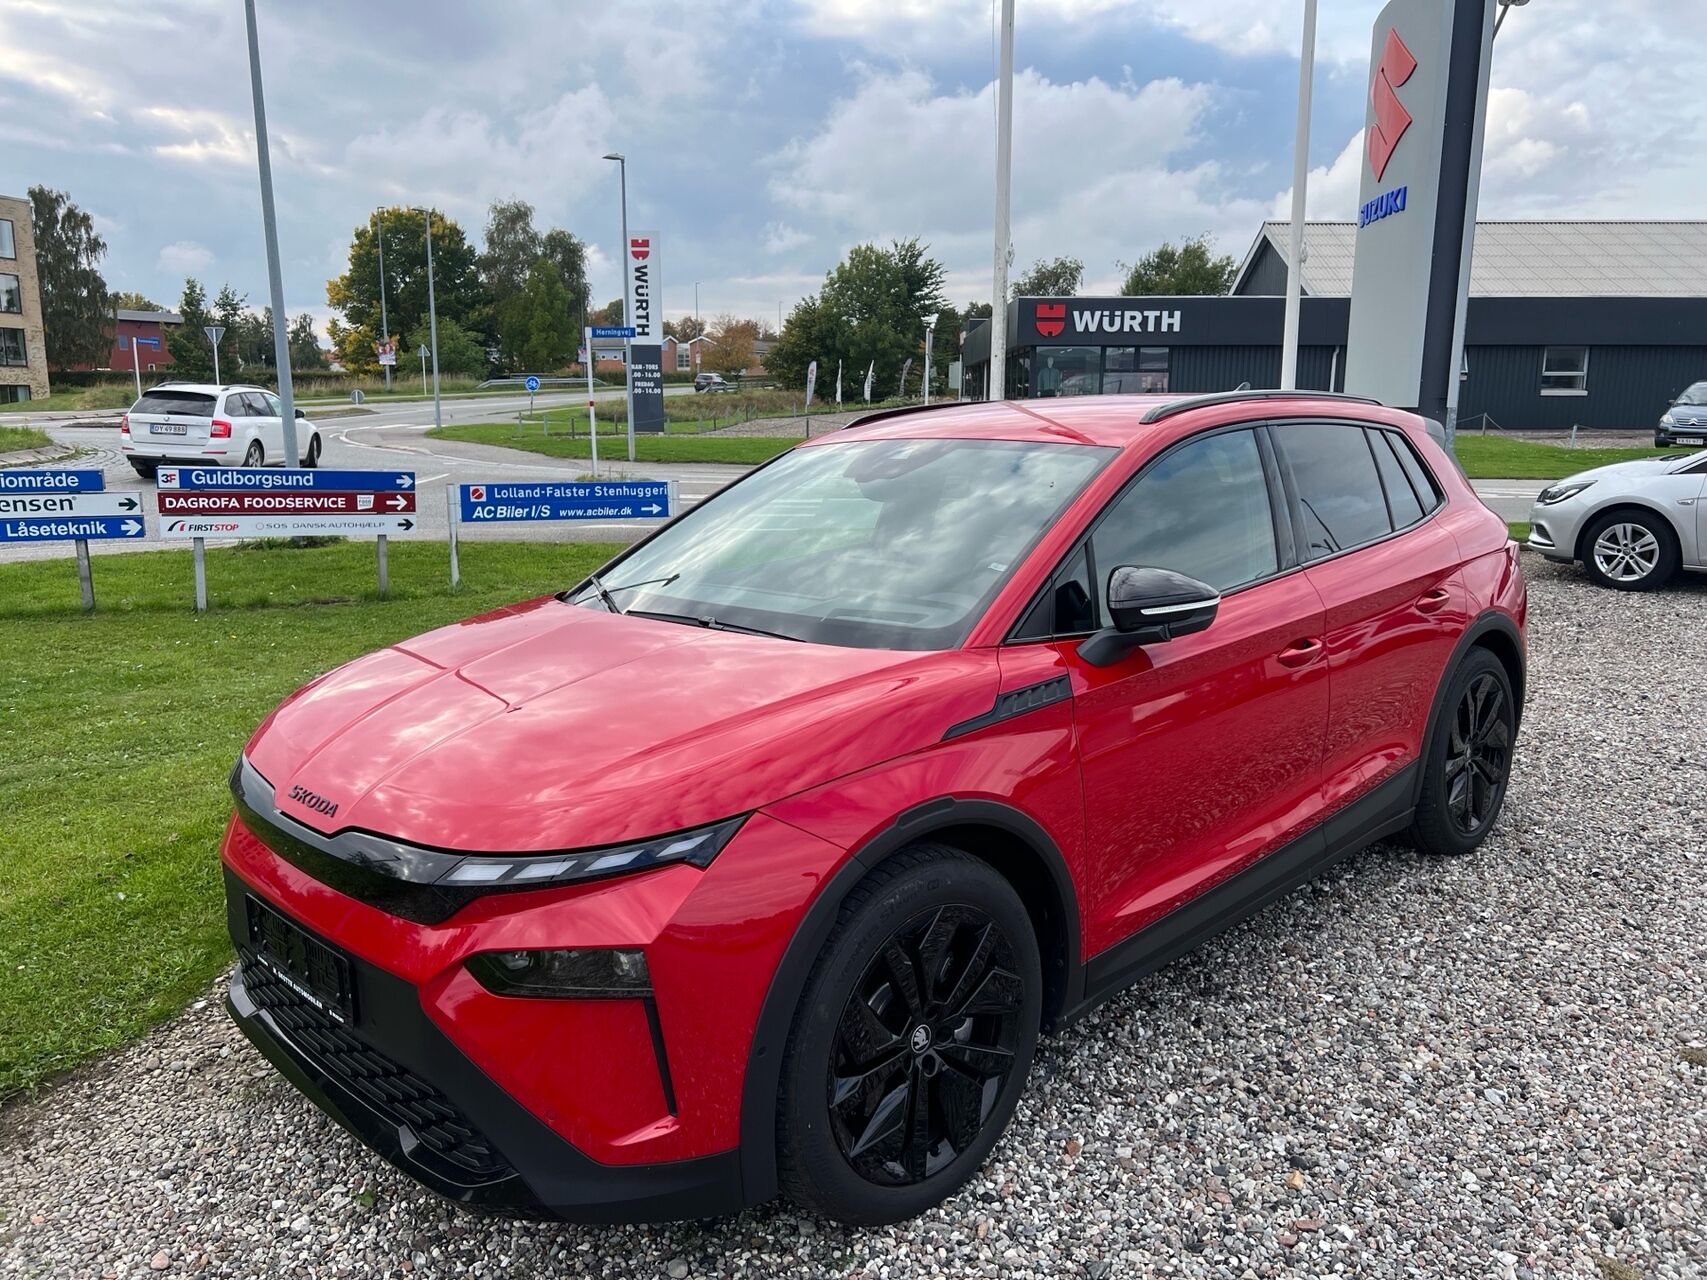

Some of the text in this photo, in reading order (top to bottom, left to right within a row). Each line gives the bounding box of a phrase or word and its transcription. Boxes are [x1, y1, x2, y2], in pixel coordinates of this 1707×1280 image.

[1360, 185, 1408, 229] SUZUKI
[634, 264, 650, 337] WÜRTH
[1072, 310, 1182, 333] WÜRTH
[161, 473, 176, 484] 3F
[191, 470, 314, 488] Guldborgsund
[494, 484, 668, 499] Lolland-Falster Stenhuggeri
[165, 497, 346, 509] DAGROFA FOODSERVICE
[472, 504, 551, 519] AC Biler I/S
[559, 506, 632, 517] www.acbiler.dk
[6, 521, 107, 537] Låseteknik
[328, 521, 385, 529] AUTOHJÆLP
